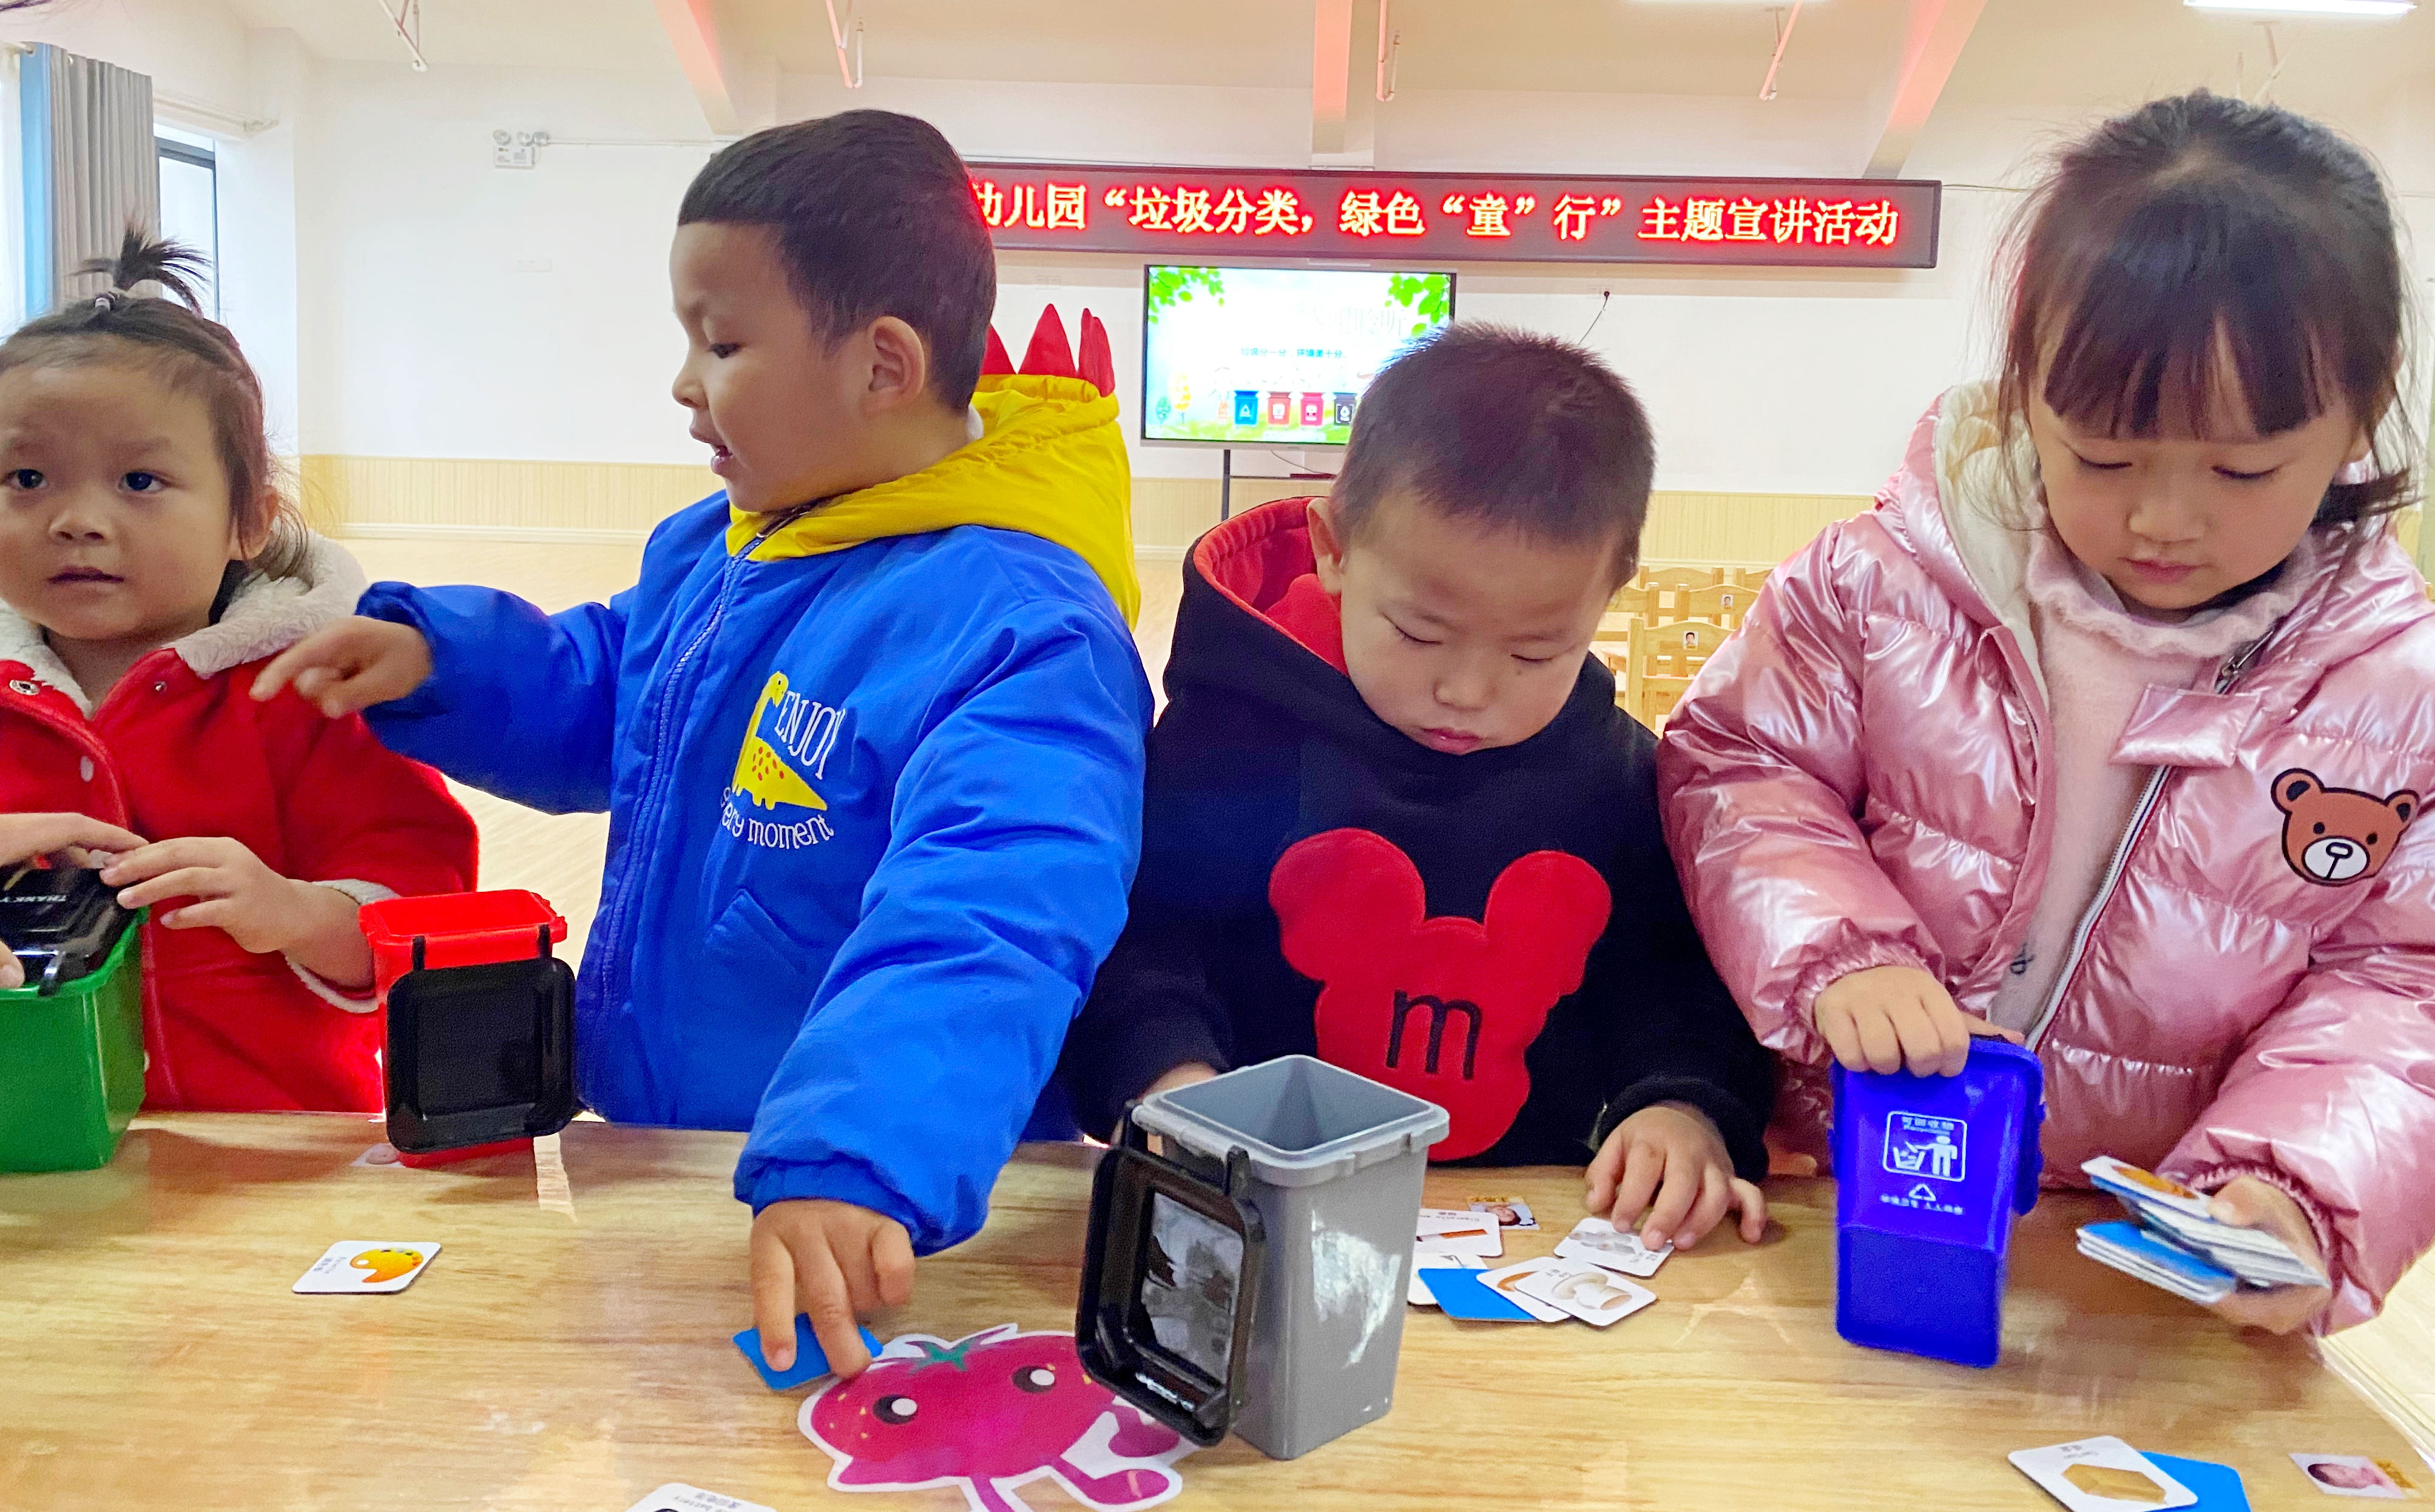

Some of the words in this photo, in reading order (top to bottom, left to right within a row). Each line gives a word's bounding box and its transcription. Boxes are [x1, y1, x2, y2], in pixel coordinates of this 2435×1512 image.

[774, 690, 846, 780] ENJOY
[747, 814, 834, 849] moment
[1386, 989, 1482, 1080] m
